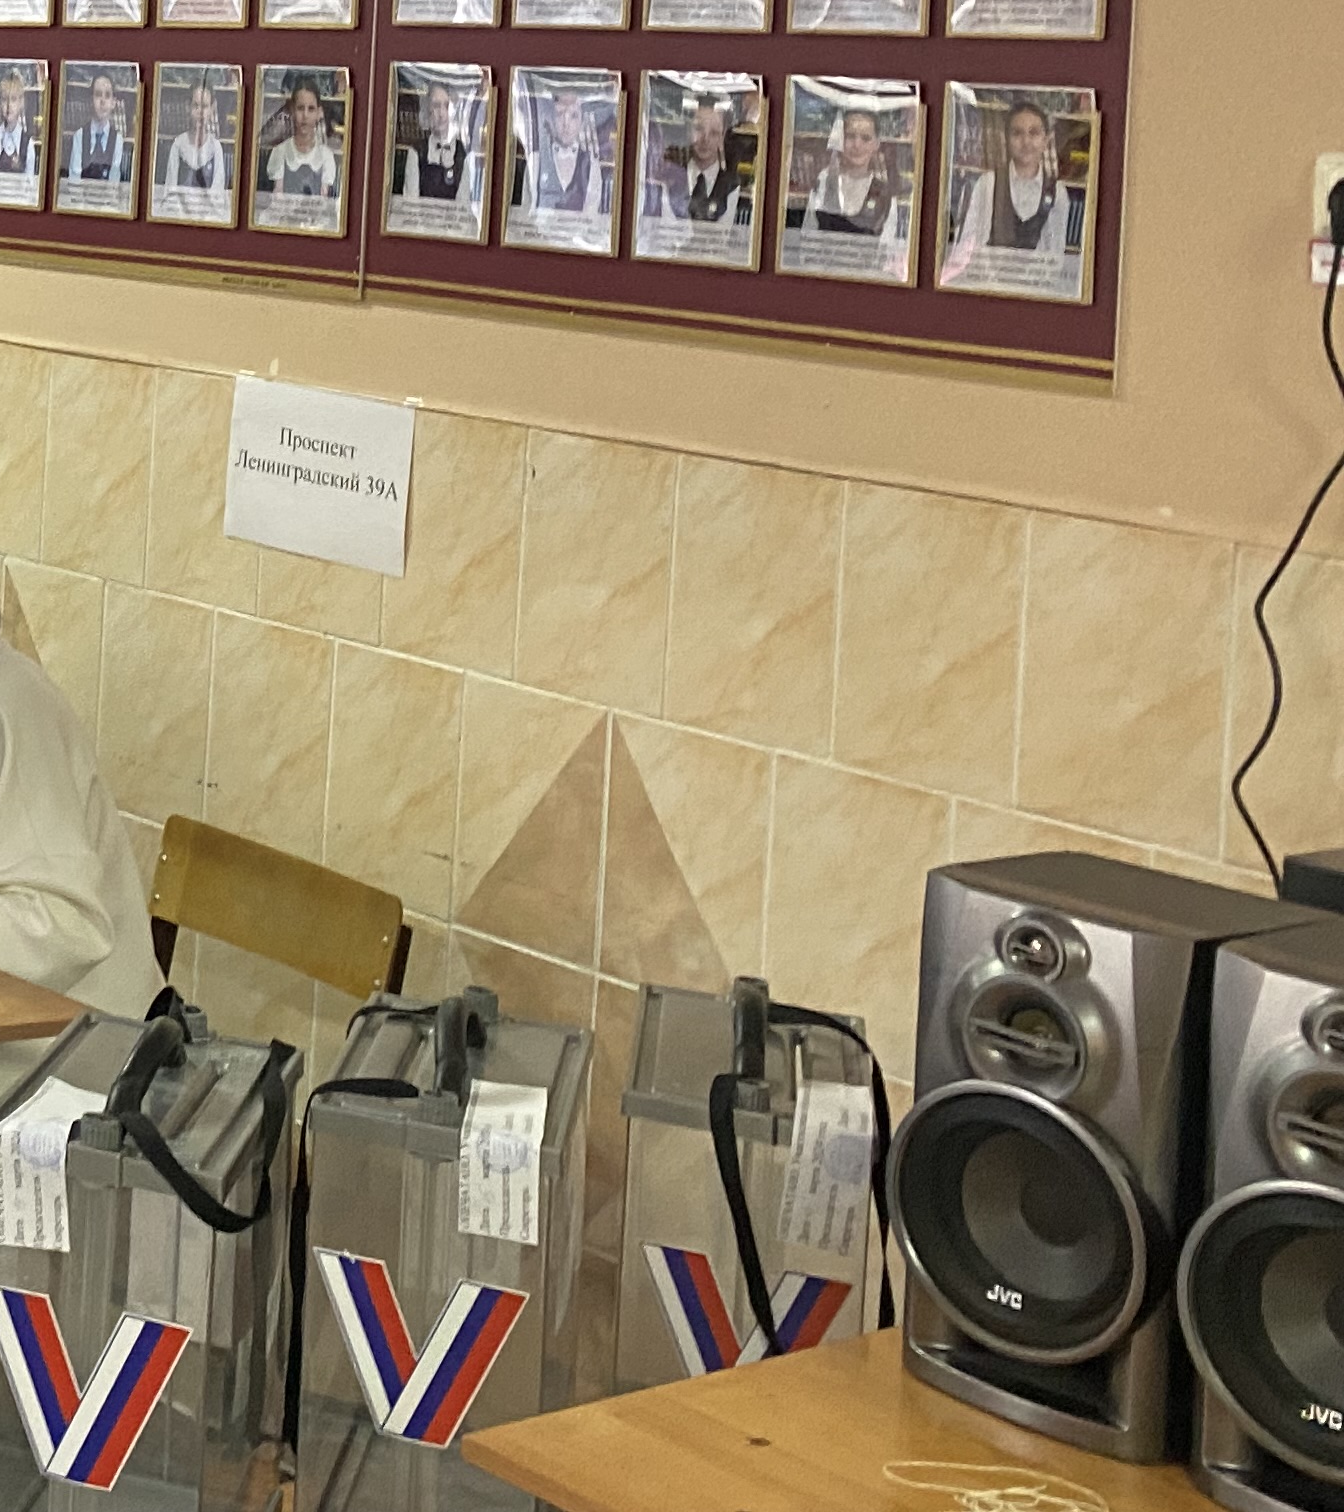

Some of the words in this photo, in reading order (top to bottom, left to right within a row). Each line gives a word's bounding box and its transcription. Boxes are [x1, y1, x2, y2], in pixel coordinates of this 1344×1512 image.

[279, 426, 358, 460] Проспект
[234, 448, 360, 493] Ленинградский
[365, 474, 398, 502] 39А
[986, 1284, 1023, 1311] JVC
[1300, 1403, 1343, 1431] JVC
